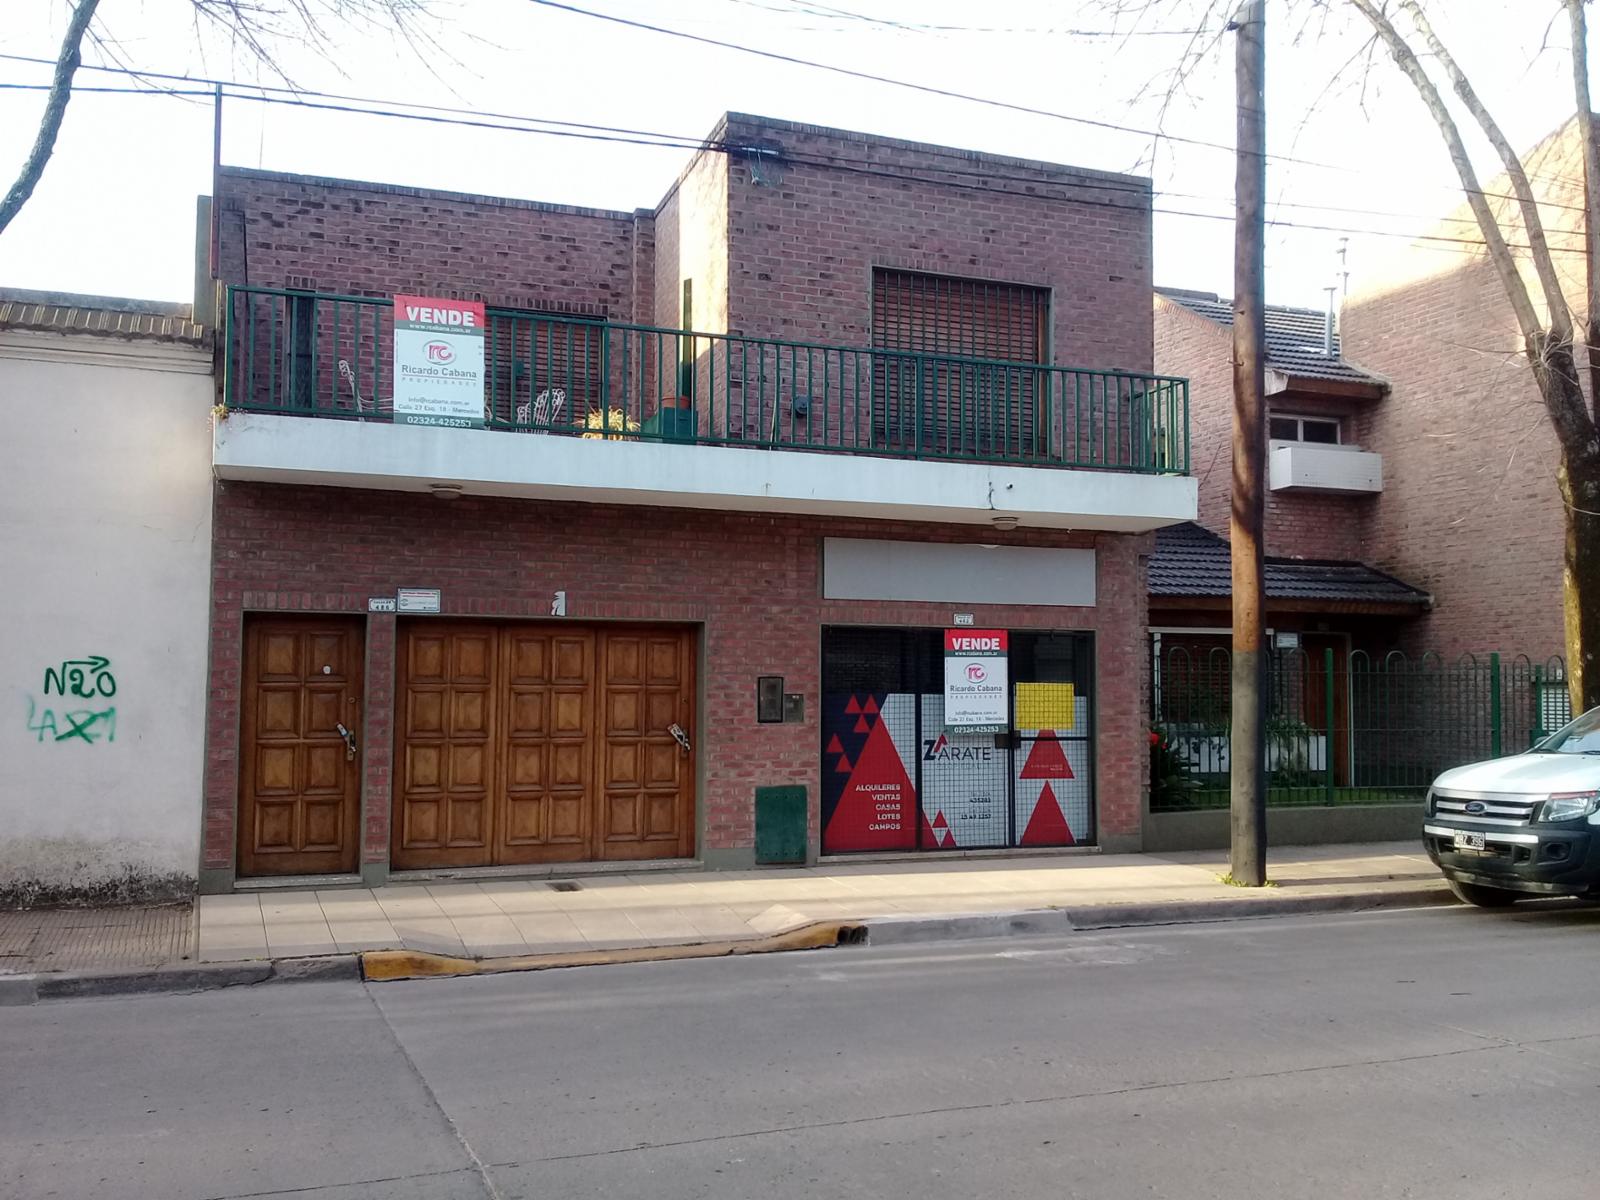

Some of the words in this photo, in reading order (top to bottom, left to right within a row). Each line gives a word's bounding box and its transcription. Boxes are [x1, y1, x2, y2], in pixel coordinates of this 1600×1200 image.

[406, 306, 475, 327] VENDE
[401, 364, 439, 376] Ricardo
[441, 367, 477, 378] Cabana
[951, 637, 1001, 650] VENDE
[950, 684, 976, 692] Ricardo
[977, 684, 1002, 692] Cabana
[855, 783, 901, 792] ALQUILERES
[871, 793, 901, 801] VENTAS
[875, 803, 901, 811] CASAS
[877, 813, 901, 821] LOTES
[868, 823, 901, 831] CAMPOS
